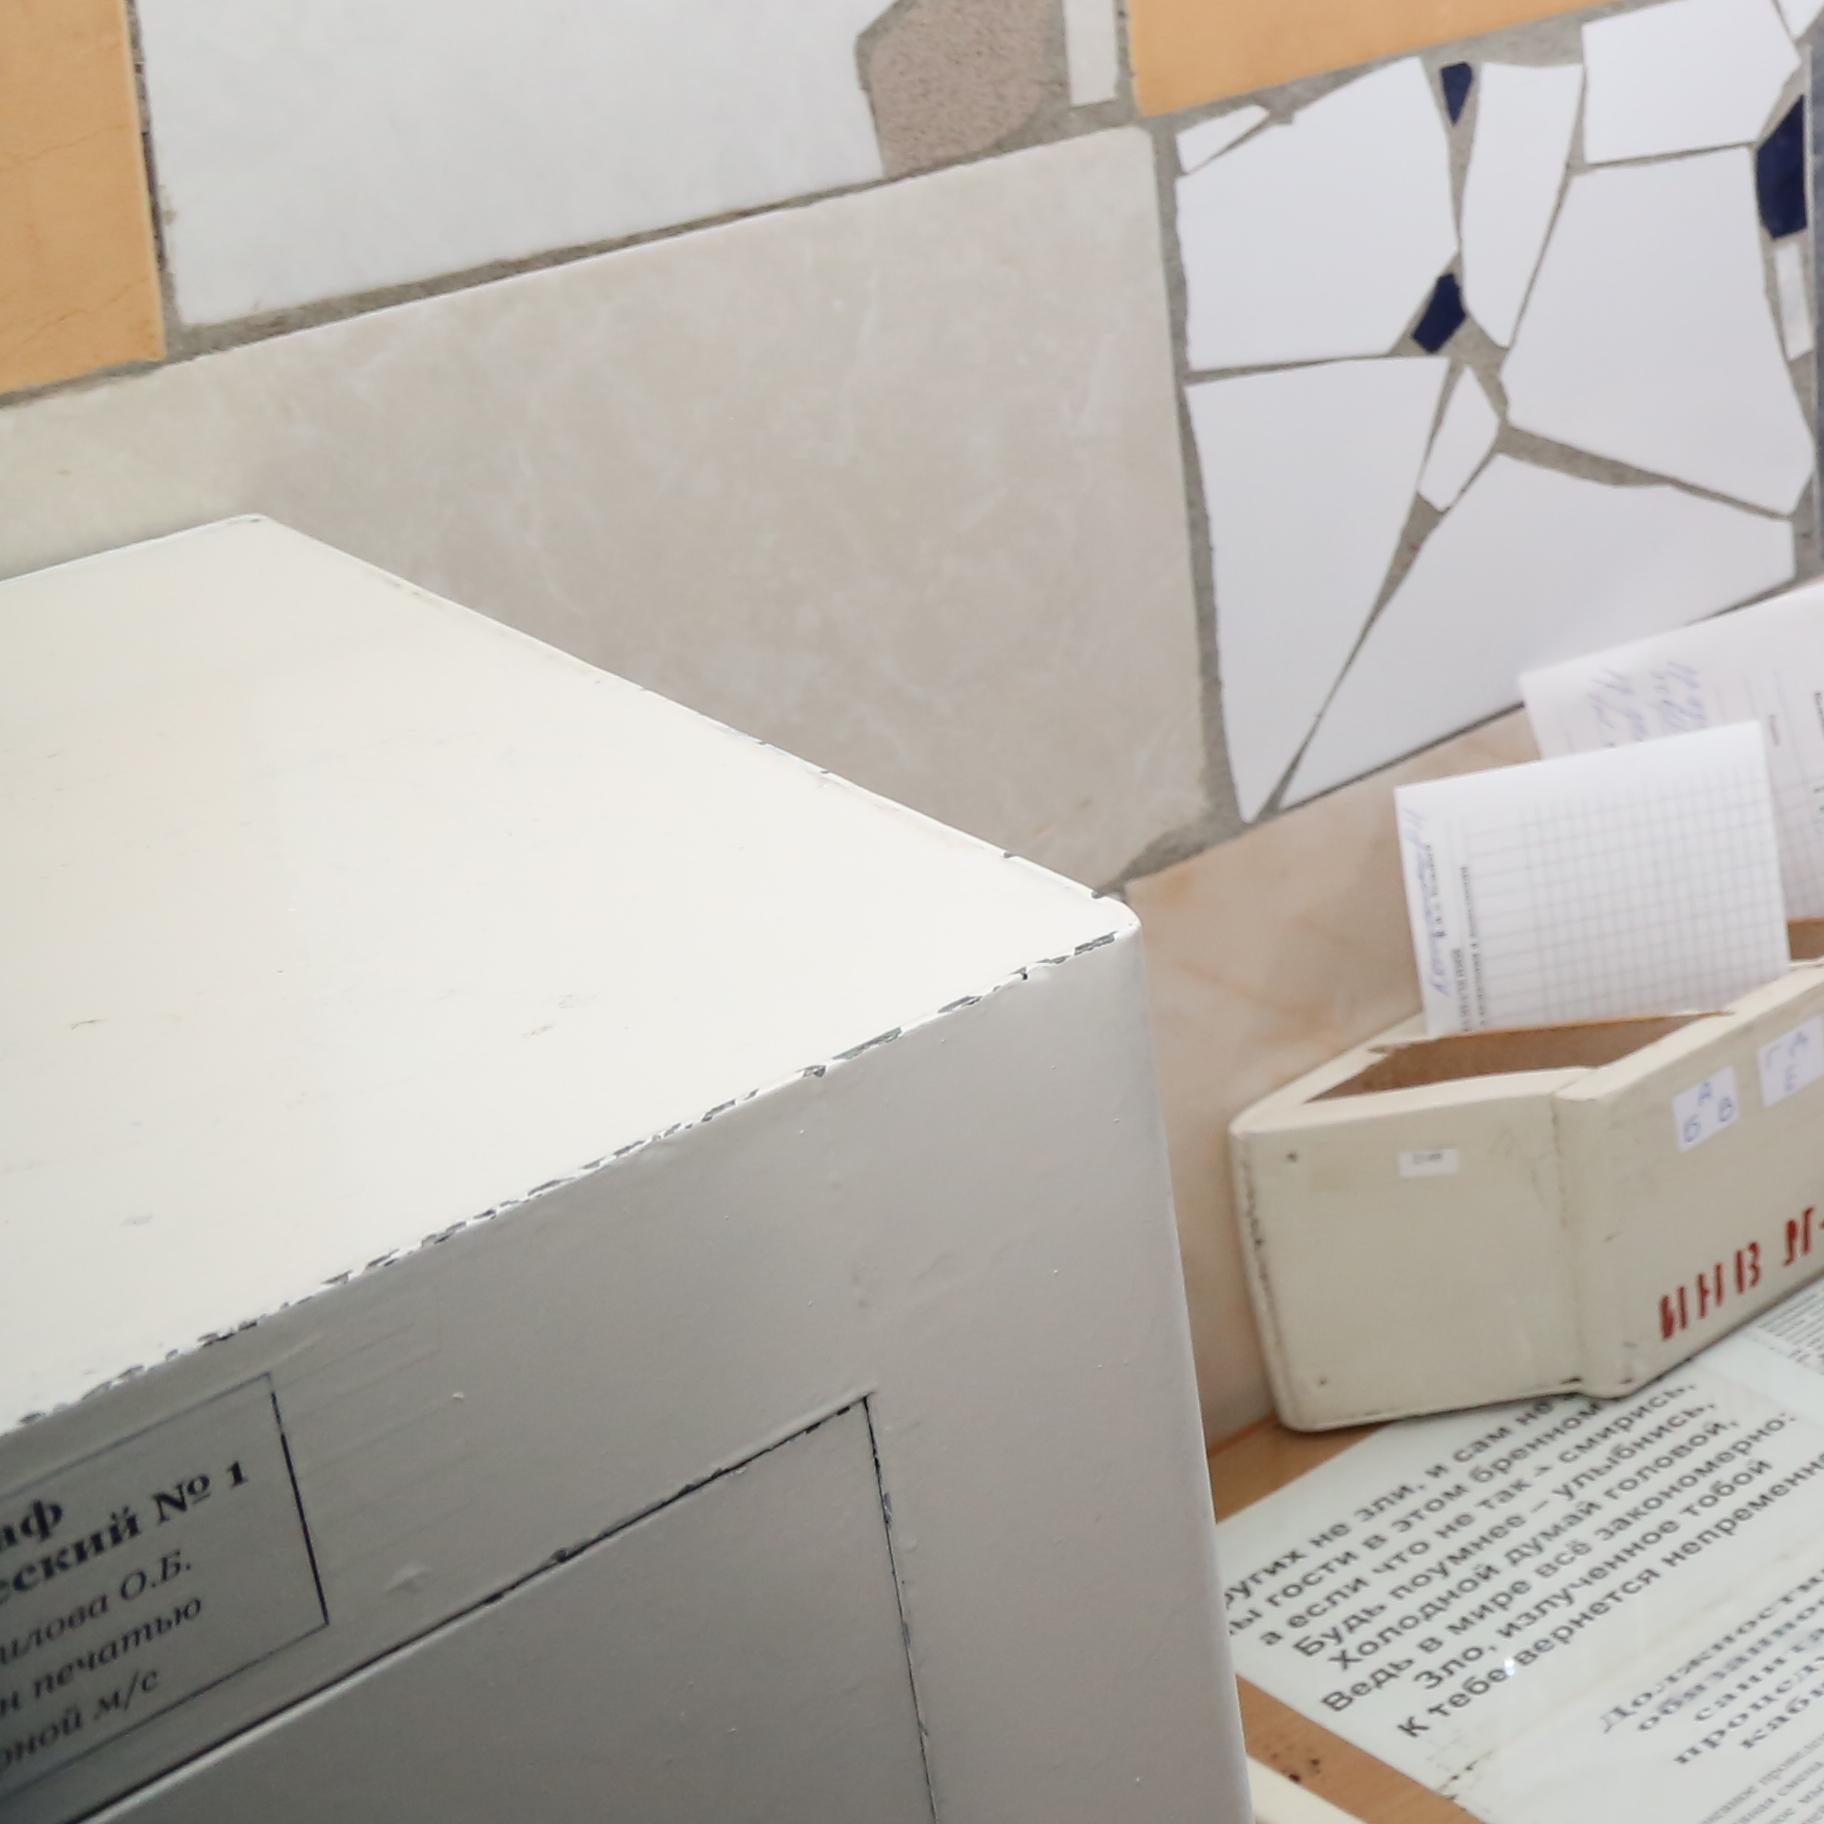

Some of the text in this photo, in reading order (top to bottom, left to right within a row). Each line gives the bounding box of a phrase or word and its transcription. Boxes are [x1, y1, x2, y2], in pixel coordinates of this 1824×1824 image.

[1659, 1240, 1762, 1341] ИНВ
[152, 1474, 211, 1524] №
[227, 1461, 248, 1490] 1
[1224, 1550, 1304, 1604] ругих
[1309, 1523, 1349, 1547] не
[1356, 1484, 1423, 1520] зли,
[1425, 1464, 1447, 1478] и
[1452, 1426, 1510, 1462] сам
[1260, 1630, 1282, 1645] а
[1287, 1577, 1368, 1628] если
[1372, 1540, 1430, 1573] что
[1435, 1513, 1473, 1538] не
[1477, 1479, 1530, 1509] так
[1558, 1385, 1694, 1463] смирись,
[1266, 1551, 1357, 1606] гости
[1362, 1534, 1386, 1550] в
[1392, 1484, 1467, 1532] этом
[1469, 1396, 1604, 1482] бренном
[1292, 1604, 1385, 1656] Будь
[1389, 1515, 1525, 1599] поумнее
[1552, 1403, 1714, 1500] улыбнись,
[1321, 1413, 1794, 1711] Ведь в мире всё закономерно:
[1329, 1421, 1737, 1670] Холодной думай головой,
[1413, 1460, 1771, 1689] Зло, излученное тобой
[0, 1549, 192, 1664] илова О.Б.
[33, 1598, 202, 1698] печатью
[93, 1671, 159, 1720] м/с
[1397, 1716, 1429, 1737] К
[1427, 1668, 1507, 1716] тебе
[1514, 1568, 1659, 1665] вернется
